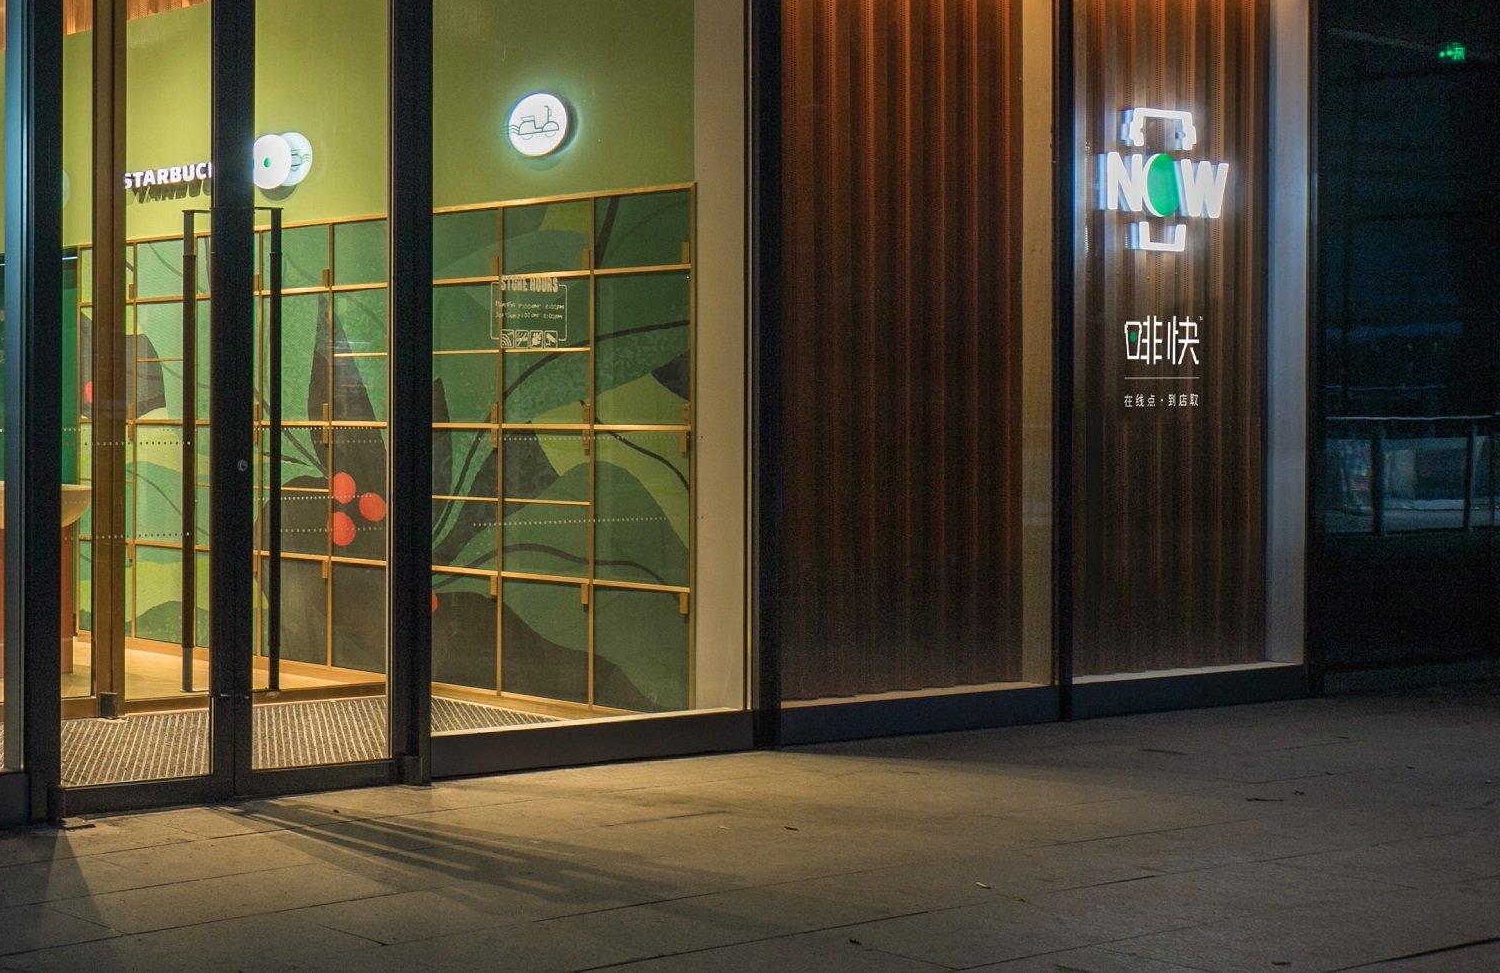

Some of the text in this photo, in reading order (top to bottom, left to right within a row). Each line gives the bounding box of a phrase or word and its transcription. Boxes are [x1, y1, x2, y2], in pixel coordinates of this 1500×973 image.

[124, 162, 212, 189] STARBUC
[1106, 151, 1229, 219] NOW
[529, 277, 559, 293] HOURS
[1124, 315, 1200, 365] 啡快
